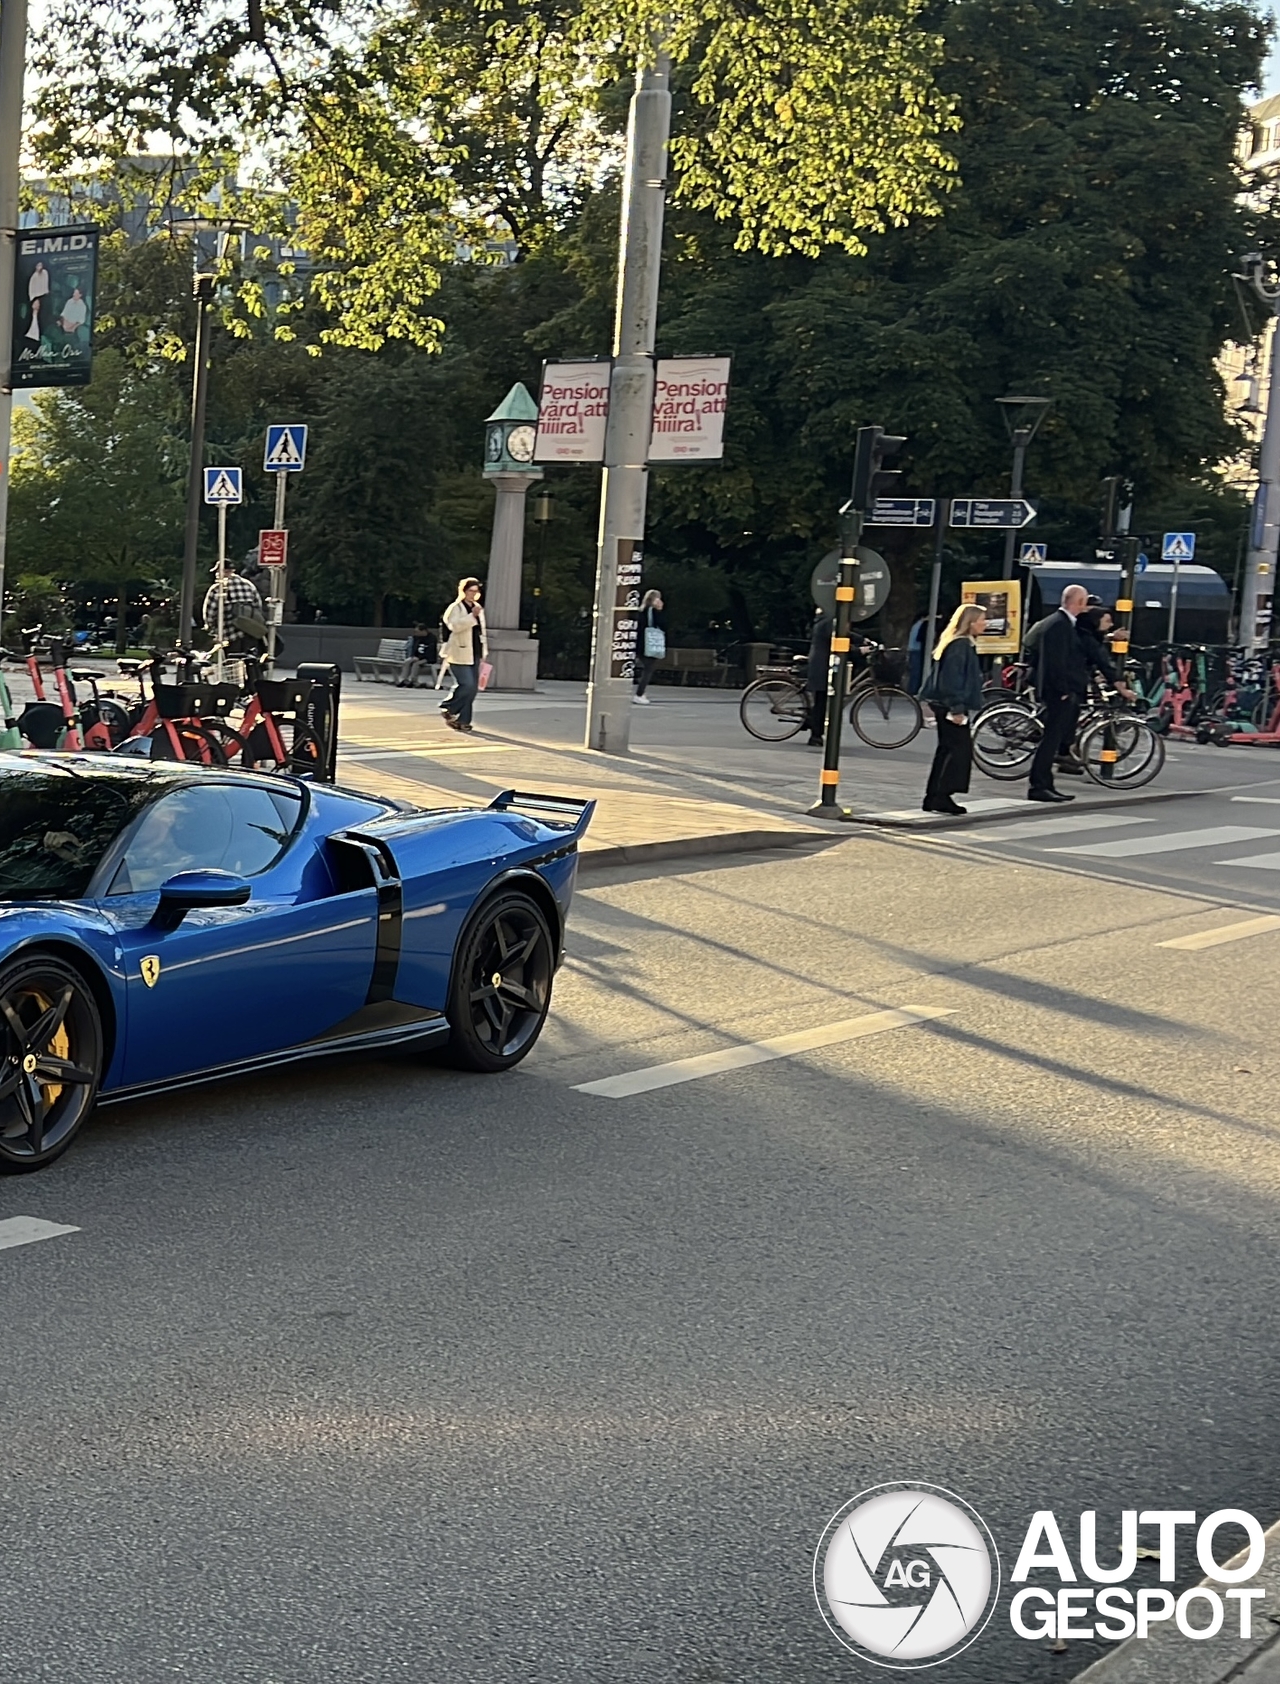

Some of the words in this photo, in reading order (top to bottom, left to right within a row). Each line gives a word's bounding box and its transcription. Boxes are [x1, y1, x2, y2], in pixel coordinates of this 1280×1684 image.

[21, 234, 93, 255] E.M.D.
[542, 382, 610, 400] Pension
[655, 378, 728, 397] Pension
[1095, 549, 1115, 560] WC
